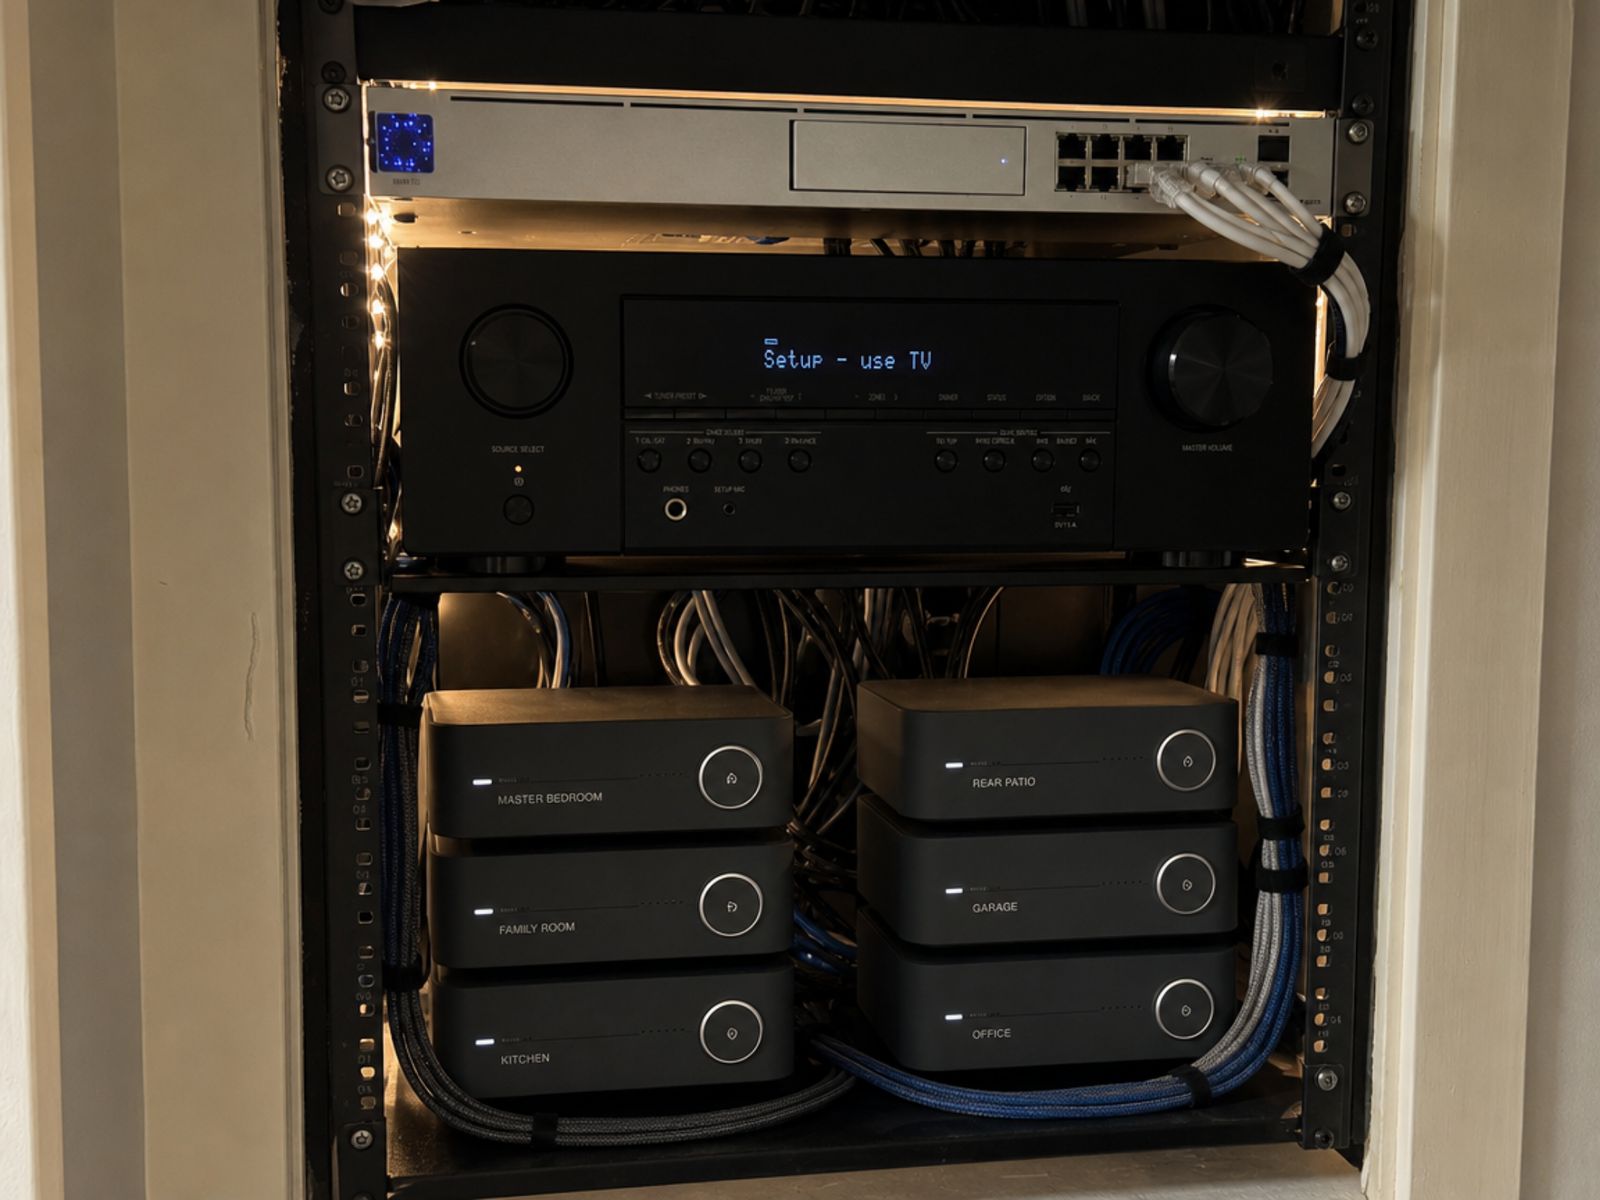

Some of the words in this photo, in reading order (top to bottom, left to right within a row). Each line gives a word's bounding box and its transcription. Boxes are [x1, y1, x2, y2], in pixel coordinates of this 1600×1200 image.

[763, 349, 824, 369] Setup
[860, 354, 896, 370] use
[909, 350, 932, 370] TV
[491, 445, 518, 453] SOURCE
[519, 445, 545, 453] SELECT
[1181, 443, 1207, 452] MASTER
[972, 777, 1003, 789] REAR
[1004, 776, 1037, 788] PATIO
[497, 793, 544, 806] MASTER
[546, 791, 603, 804] BEDROOM
[972, 901, 1019, 914] GARAGE
[499, 923, 538, 936] FAMILY
[540, 922, 576, 934] ROOM
[971, 1027, 1012, 1040] OFFICE
[500, 1053, 550, 1066] KITCHEN
